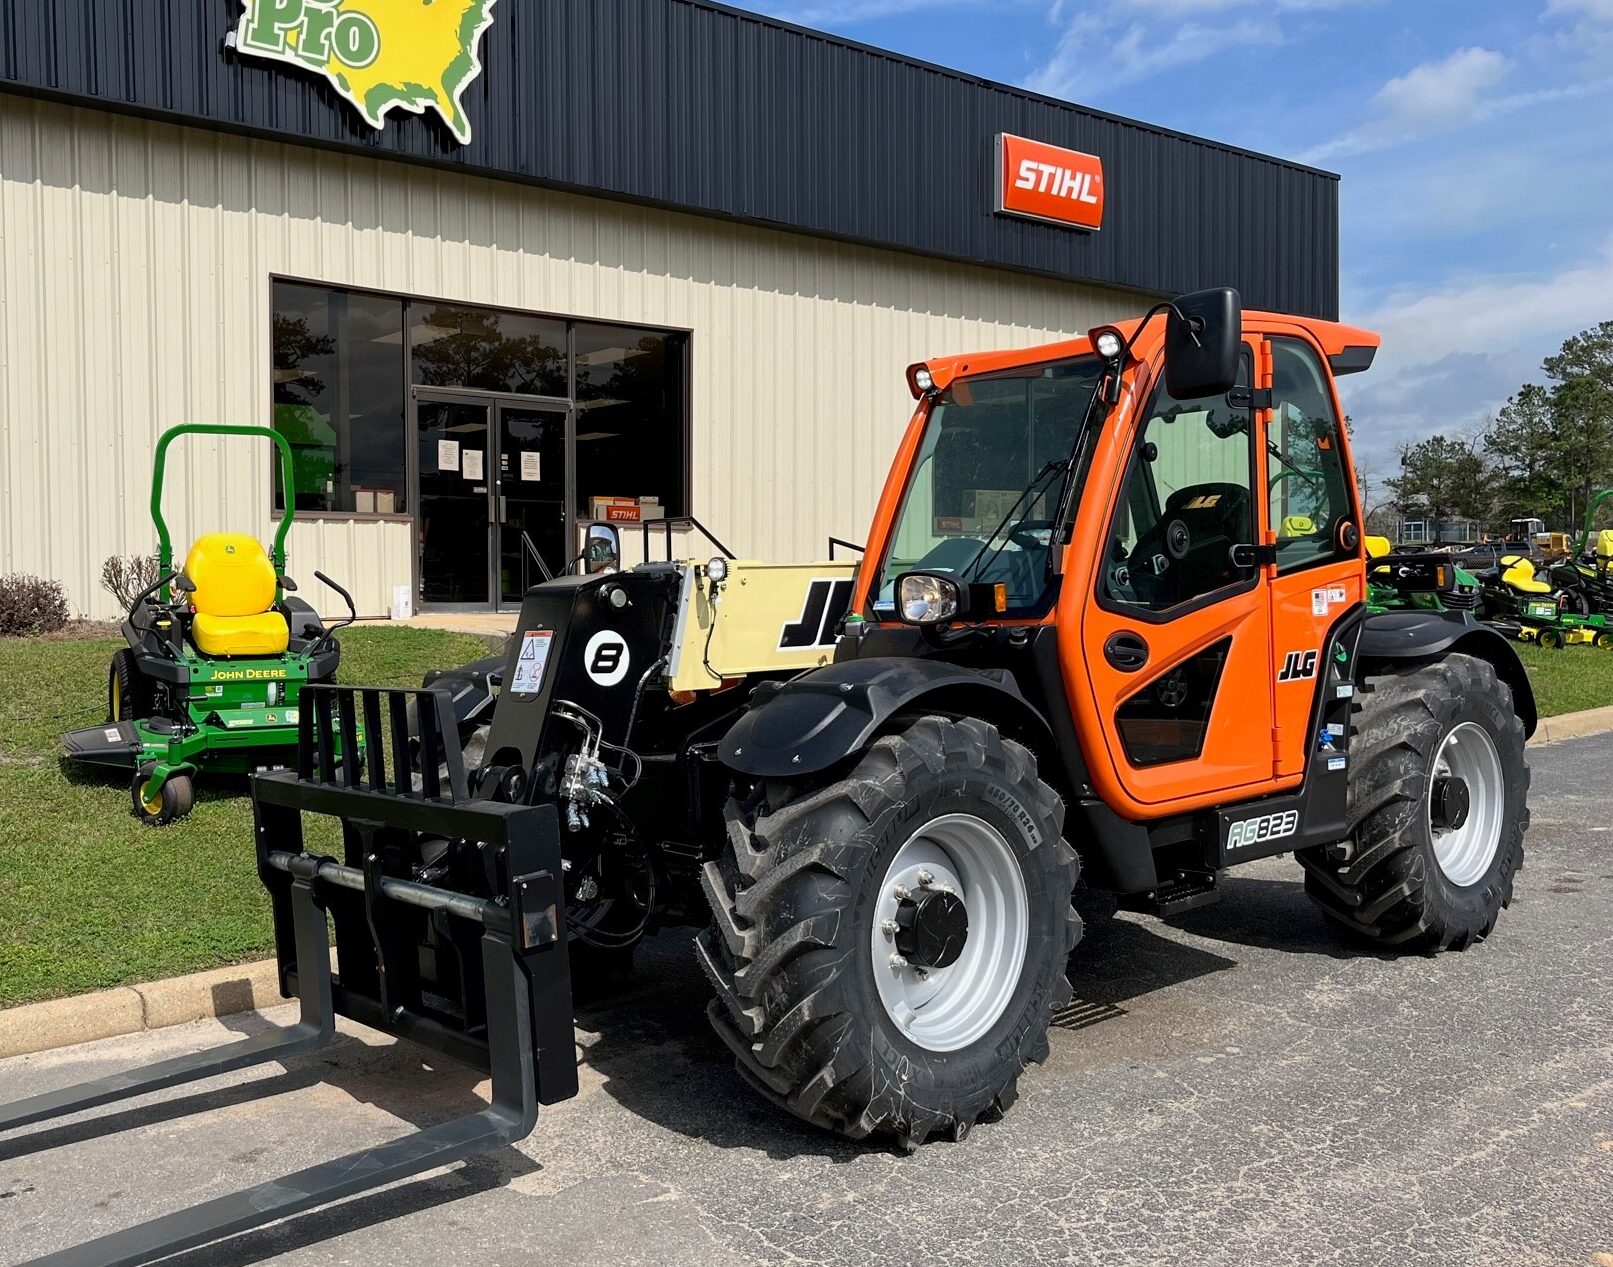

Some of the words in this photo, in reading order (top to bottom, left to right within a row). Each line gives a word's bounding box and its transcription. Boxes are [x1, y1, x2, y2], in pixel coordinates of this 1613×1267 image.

[245, 0, 380, 69] Pro
[1014, 158, 1098, 205] STIHL
[610, 510, 639, 520] STIHL
[1182, 494, 1223, 510] JLG
[210, 670, 244, 680] JOHN
[245, 669, 287, 679] DEERE
[590, 642, 624, 674] 8
[1277, 649, 1318, 683] JLG
[1226, 809, 1299, 849] AG823
